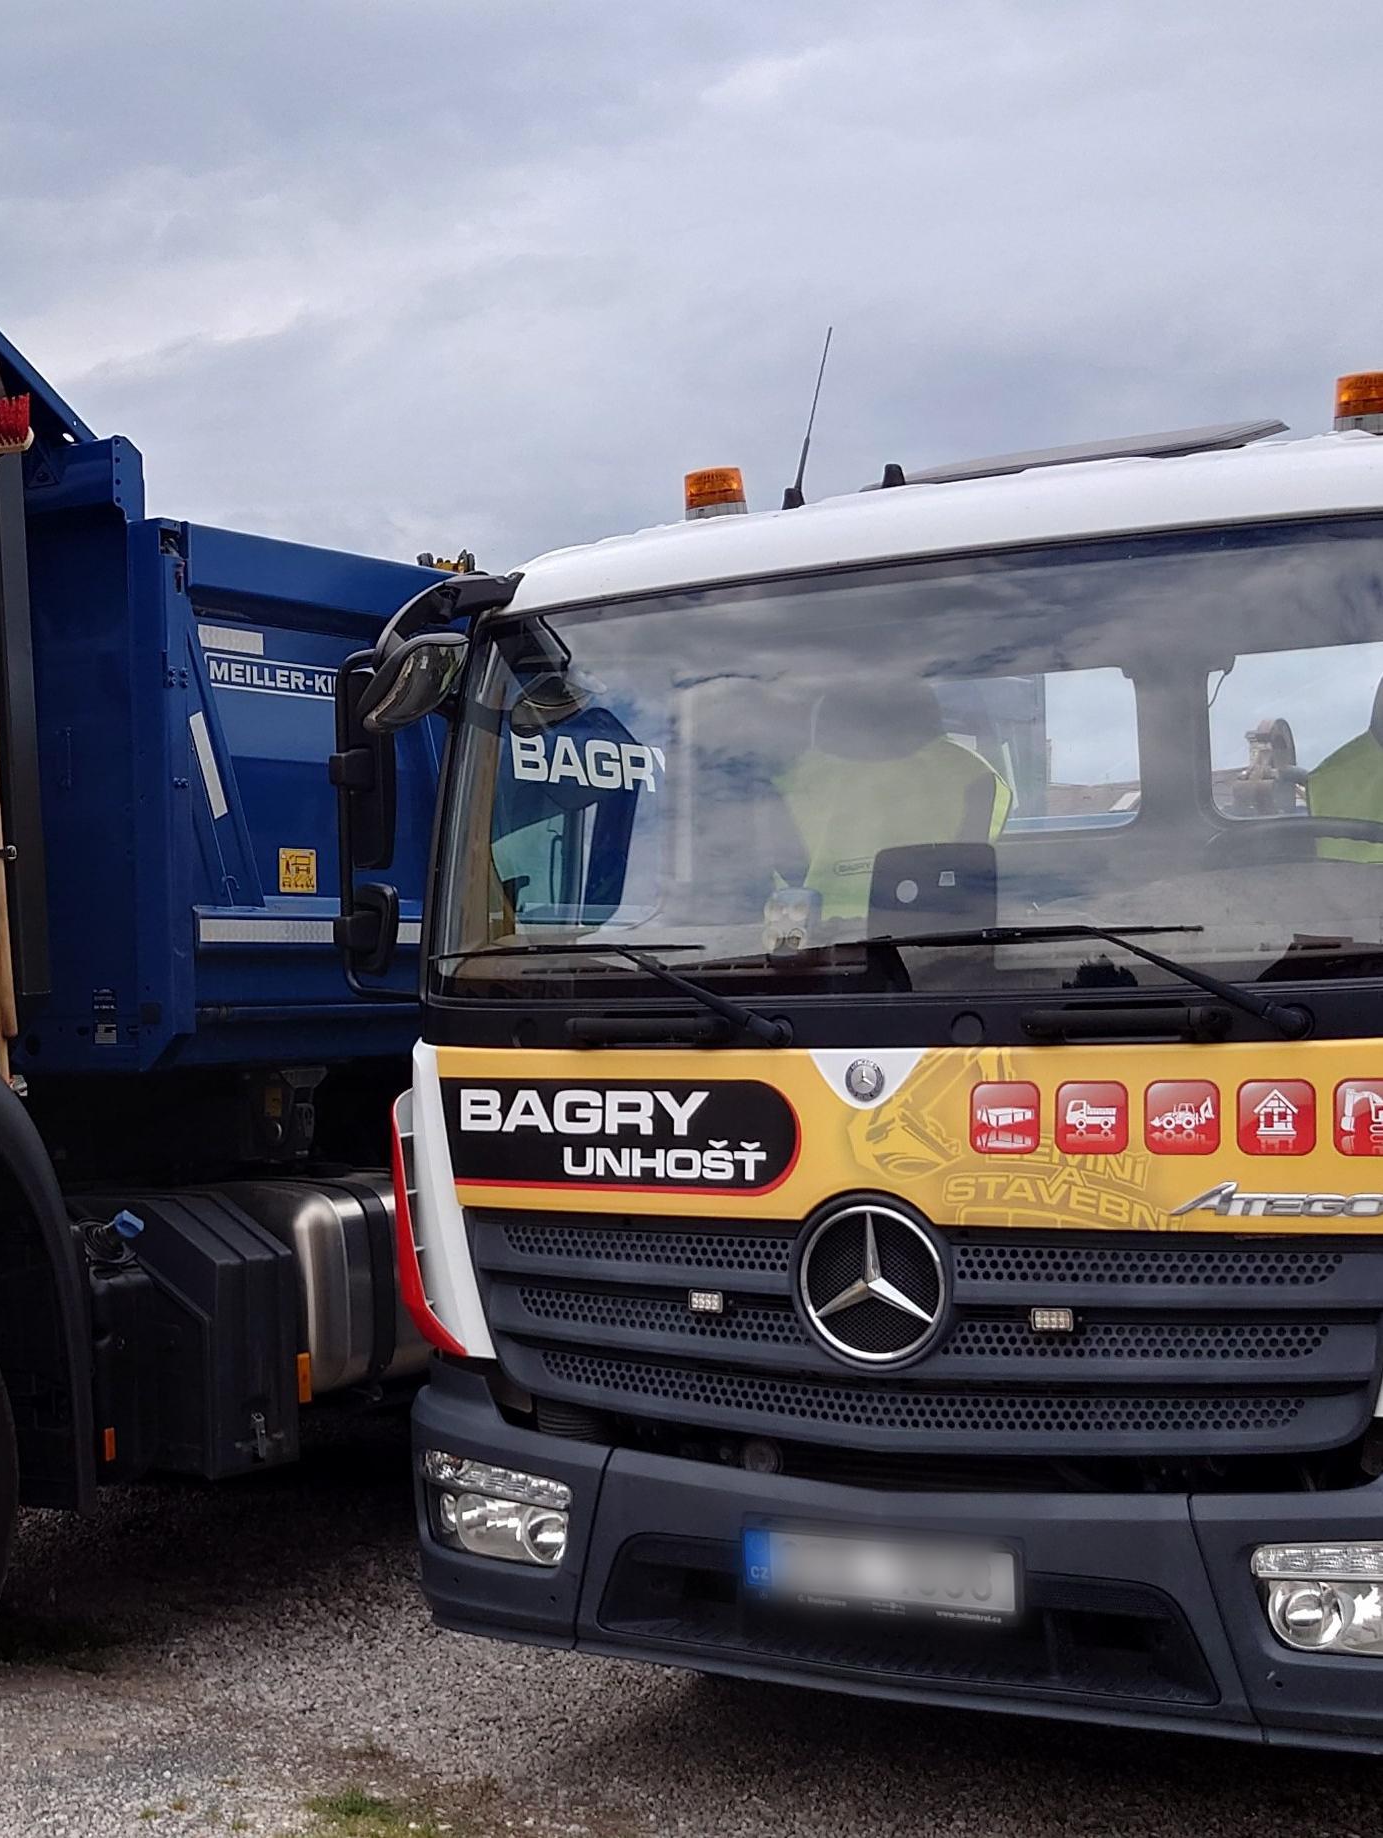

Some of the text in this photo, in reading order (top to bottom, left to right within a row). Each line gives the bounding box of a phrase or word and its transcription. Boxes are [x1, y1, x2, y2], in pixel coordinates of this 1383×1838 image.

[209, 660, 336, 694] MEILLER-KI
[460, 1088, 710, 1136] BAGRY
[563, 1139, 767, 1181] UNHOŠŤ
[750, 1564, 769, 1580] CZ
